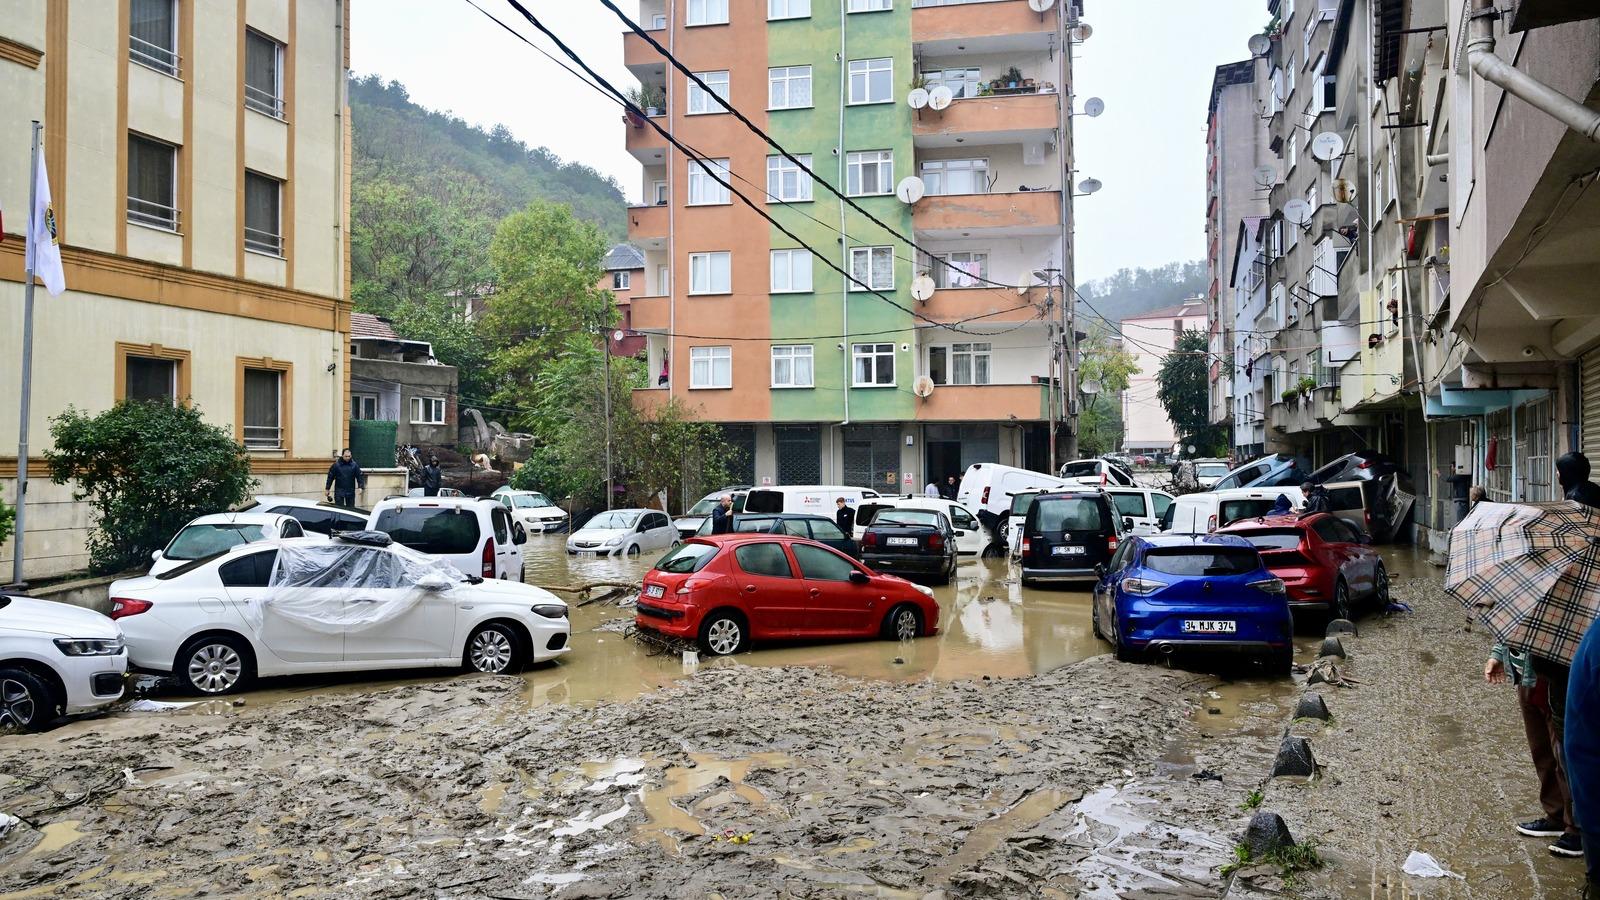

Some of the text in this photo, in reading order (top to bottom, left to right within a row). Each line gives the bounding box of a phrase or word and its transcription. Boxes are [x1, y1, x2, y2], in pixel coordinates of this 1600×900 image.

[1185, 621, 1234, 631] 34 MJK 374
